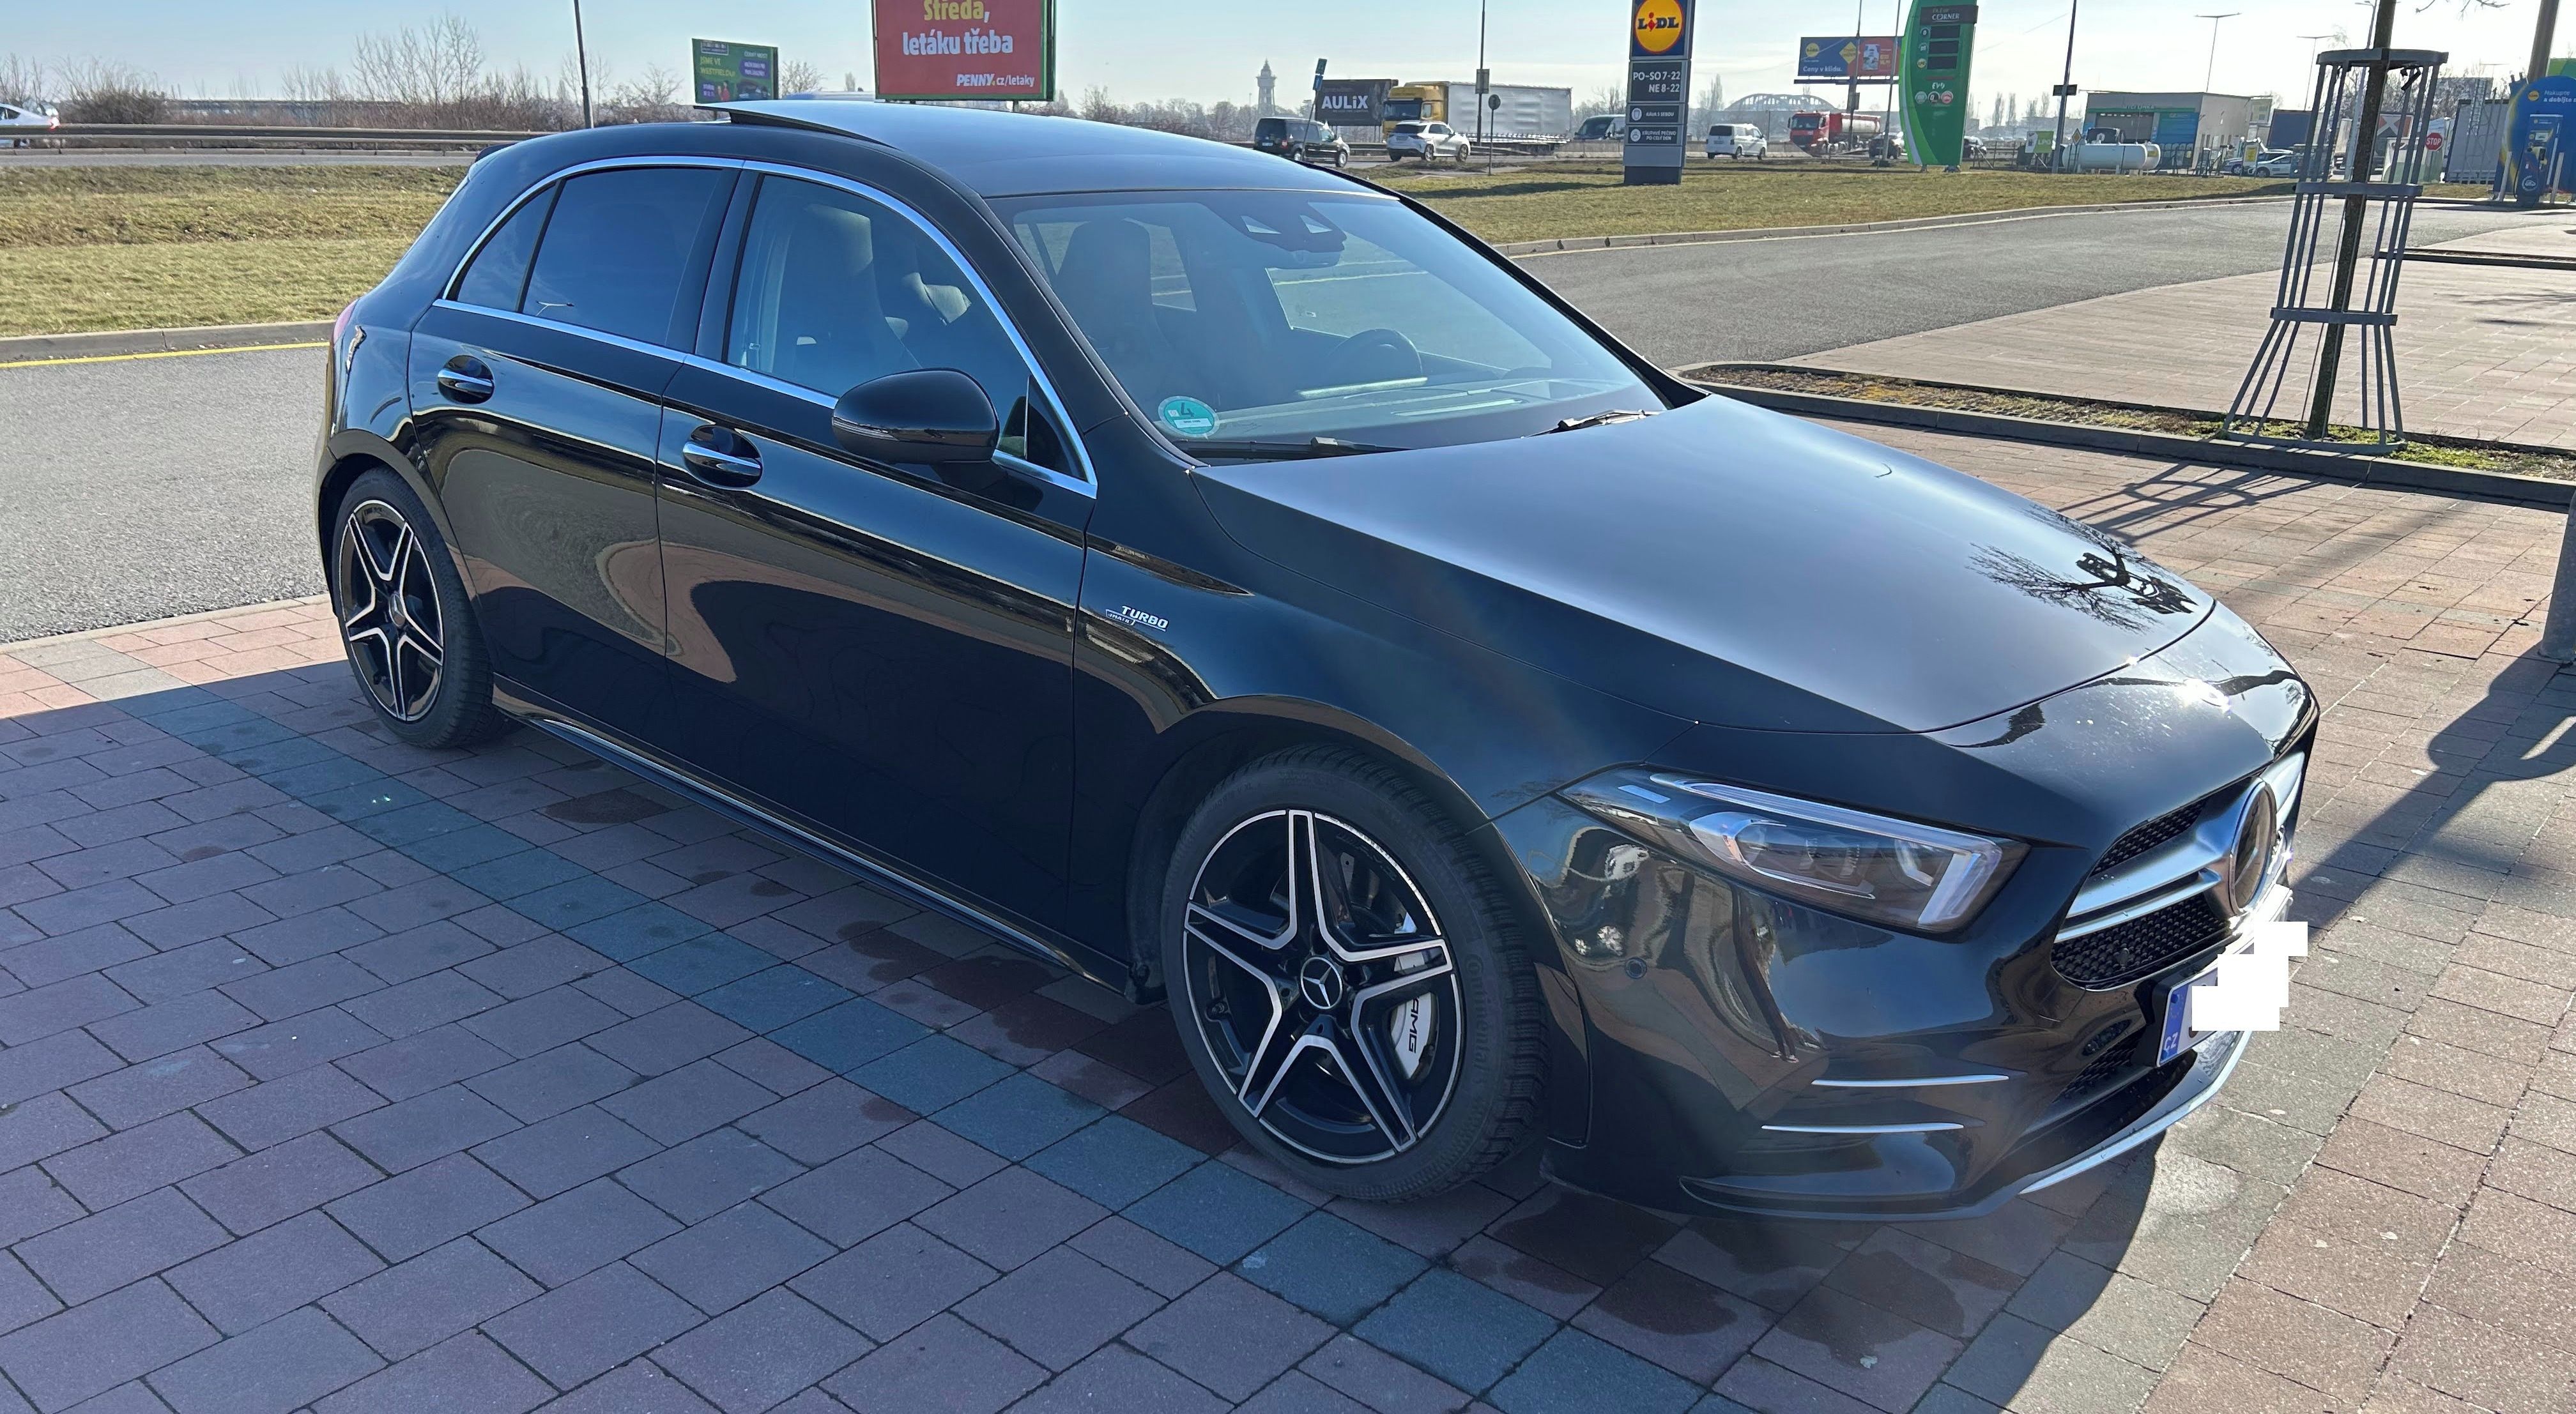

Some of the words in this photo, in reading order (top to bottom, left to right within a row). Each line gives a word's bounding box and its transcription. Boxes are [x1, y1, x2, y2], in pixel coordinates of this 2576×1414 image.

[924, 0, 990, 23] Středa,
[903, 29, 961, 55] letáku
[964, 28, 1013, 54] třeba
[956, 73, 1034, 87] PENNY.cz/letaky
[1662, 72, 1681, 80] 7-22
[1648, 84, 1660, 93] NE
[1661, 84, 1680, 93] 8-22
[2426, 137, 2442, 146] STOP
[1181, 402, 1194, 417] 4
[1122, 605, 1169, 628] TURBO
[1409, 997, 1420, 1054] AMG
[2164, 1032, 2178, 1051] CZ
